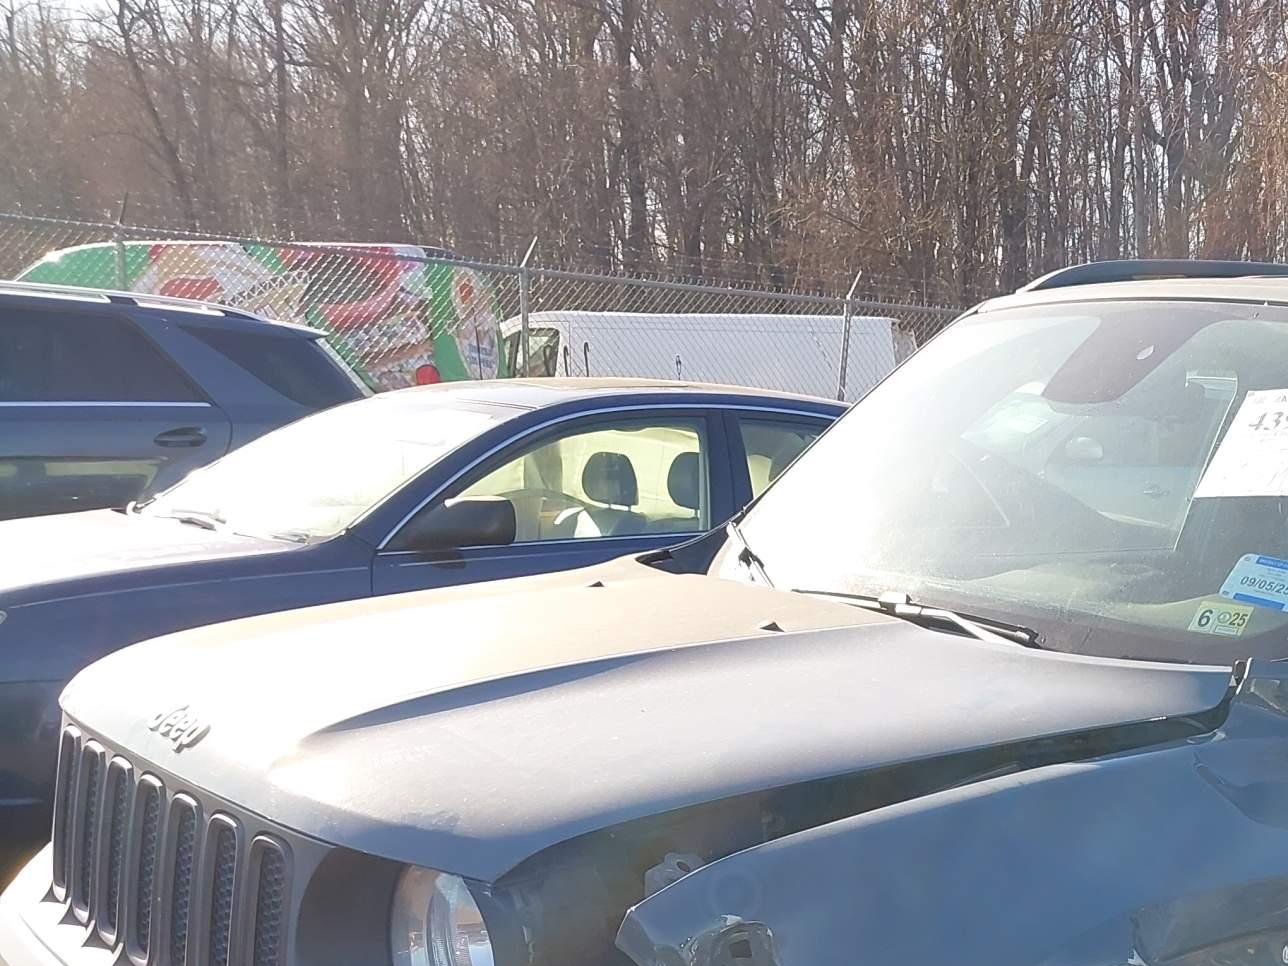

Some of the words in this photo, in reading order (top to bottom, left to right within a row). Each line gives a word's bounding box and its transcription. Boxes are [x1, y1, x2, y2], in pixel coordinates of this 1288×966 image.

[1198, 609, 1213, 628] 6
[1229, 612, 1249, 627] 25
[147, 704, 211, 754] Jeep
